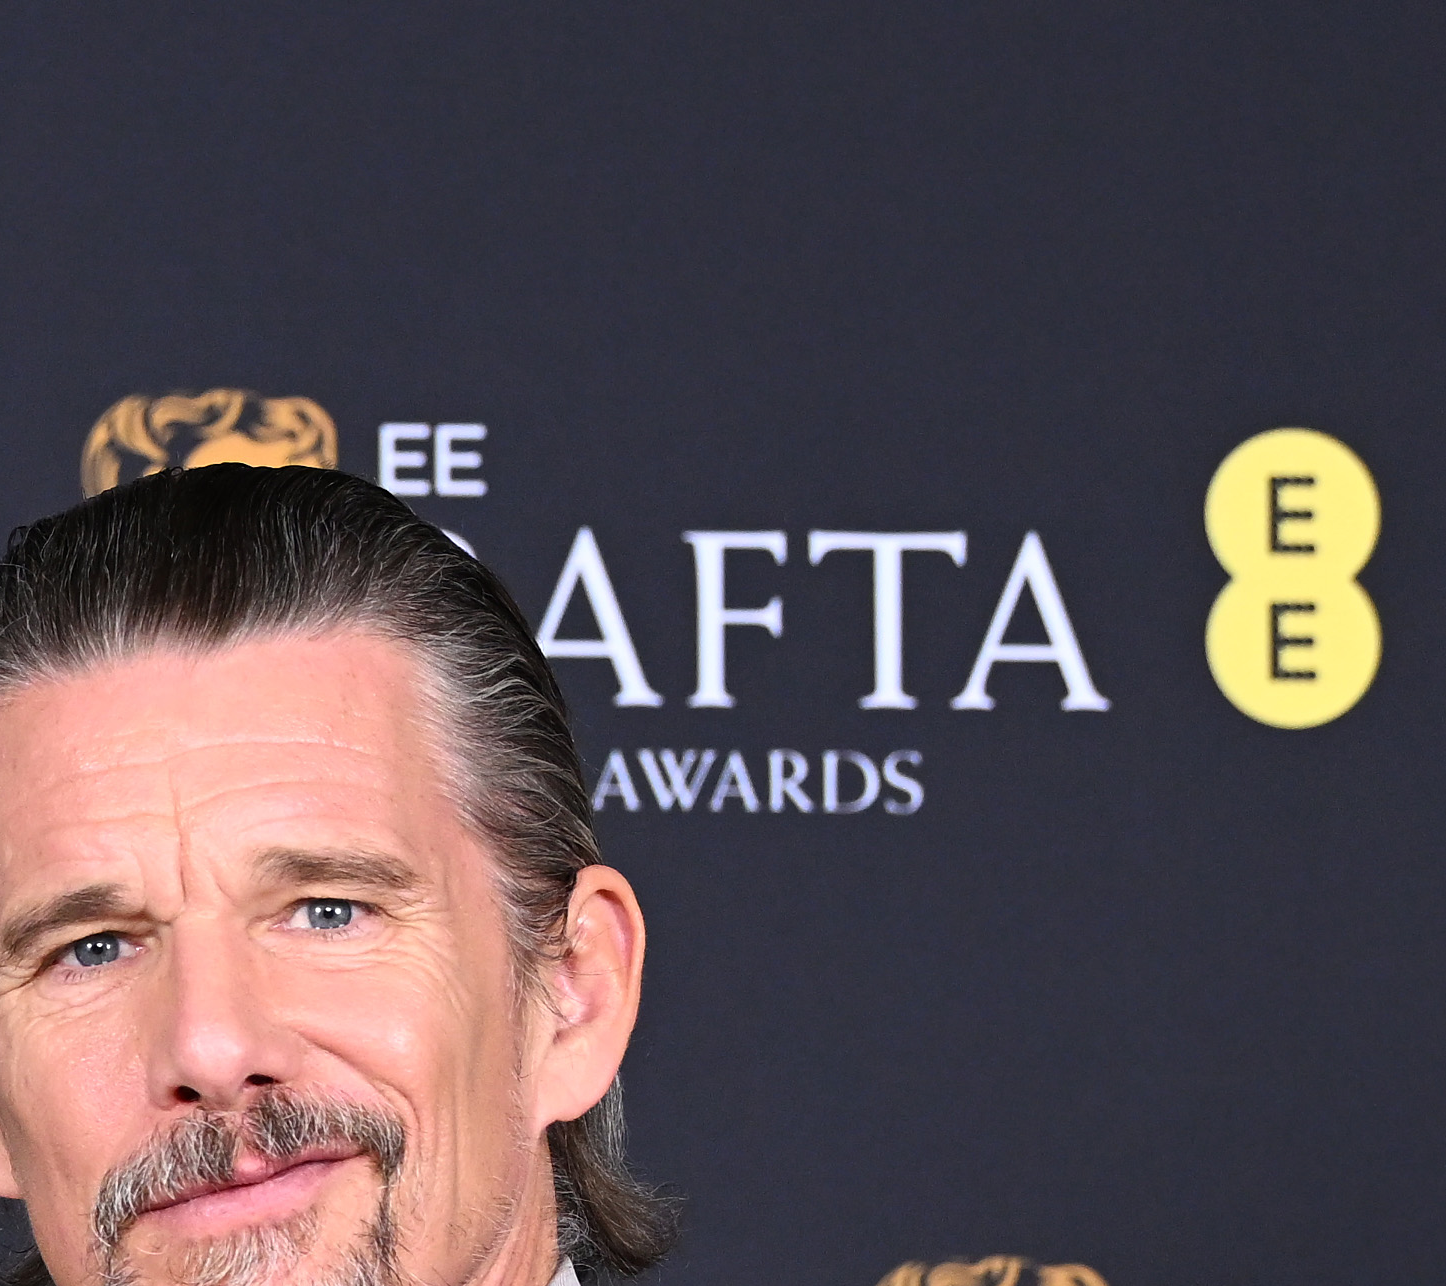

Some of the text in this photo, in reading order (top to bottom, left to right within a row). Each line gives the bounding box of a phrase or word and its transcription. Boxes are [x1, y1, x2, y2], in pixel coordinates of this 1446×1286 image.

[378, 422, 489, 497] EE
[442, 526, 1111, 712] AFTA
[592, 748, 925, 815] AWARDS
